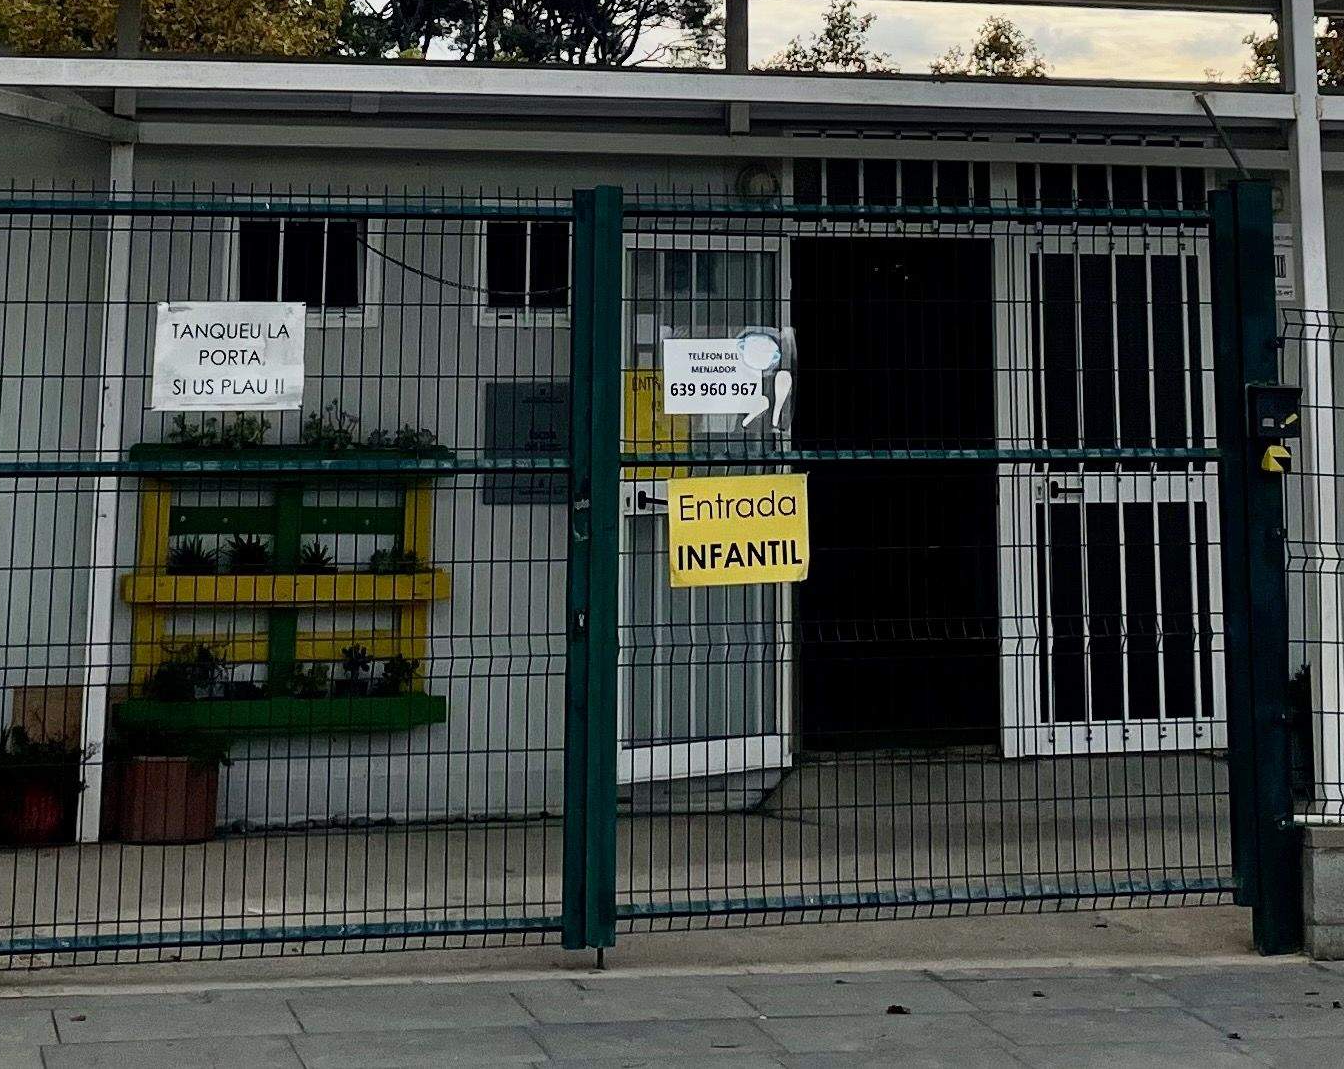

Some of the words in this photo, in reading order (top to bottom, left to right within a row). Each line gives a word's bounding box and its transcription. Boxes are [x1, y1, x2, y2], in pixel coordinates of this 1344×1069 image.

[172, 323, 262, 340] TANQUEU
[268, 323, 290, 339] LA
[725, 352, 739, 361] DEL
[172, 379, 186, 395] SI
[193, 379, 214, 395] US
[221, 379, 268, 395] PLAU
[670, 383, 696, 397] 639
[700, 383, 727, 396] 960
[731, 383, 757, 396] 967
[679, 490, 797, 521] Entrada
[678, 539, 803, 571] INFANTIL
